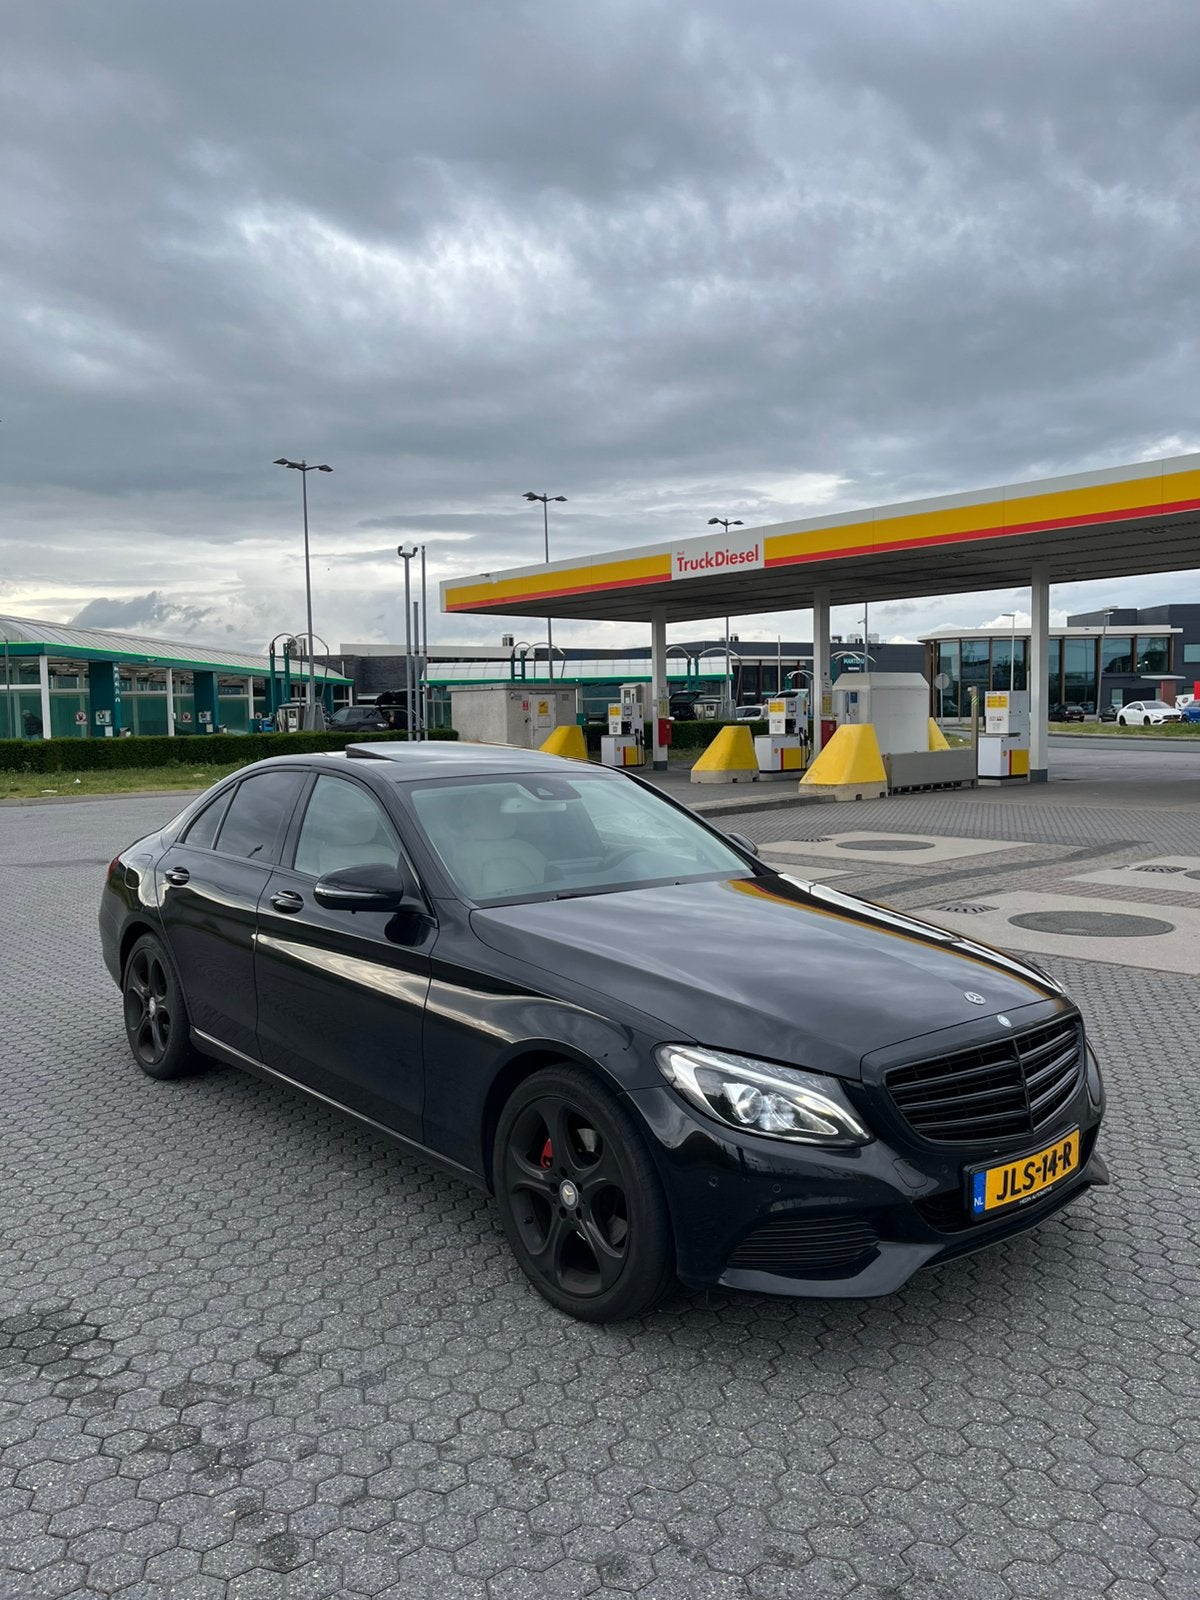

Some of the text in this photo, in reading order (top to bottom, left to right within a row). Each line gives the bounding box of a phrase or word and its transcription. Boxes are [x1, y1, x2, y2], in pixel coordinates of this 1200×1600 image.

[677, 544, 759, 572] TruckDiesel
[996, 1141, 1072, 1201] JLS-14-R
[974, 1196, 984, 1207] NL
